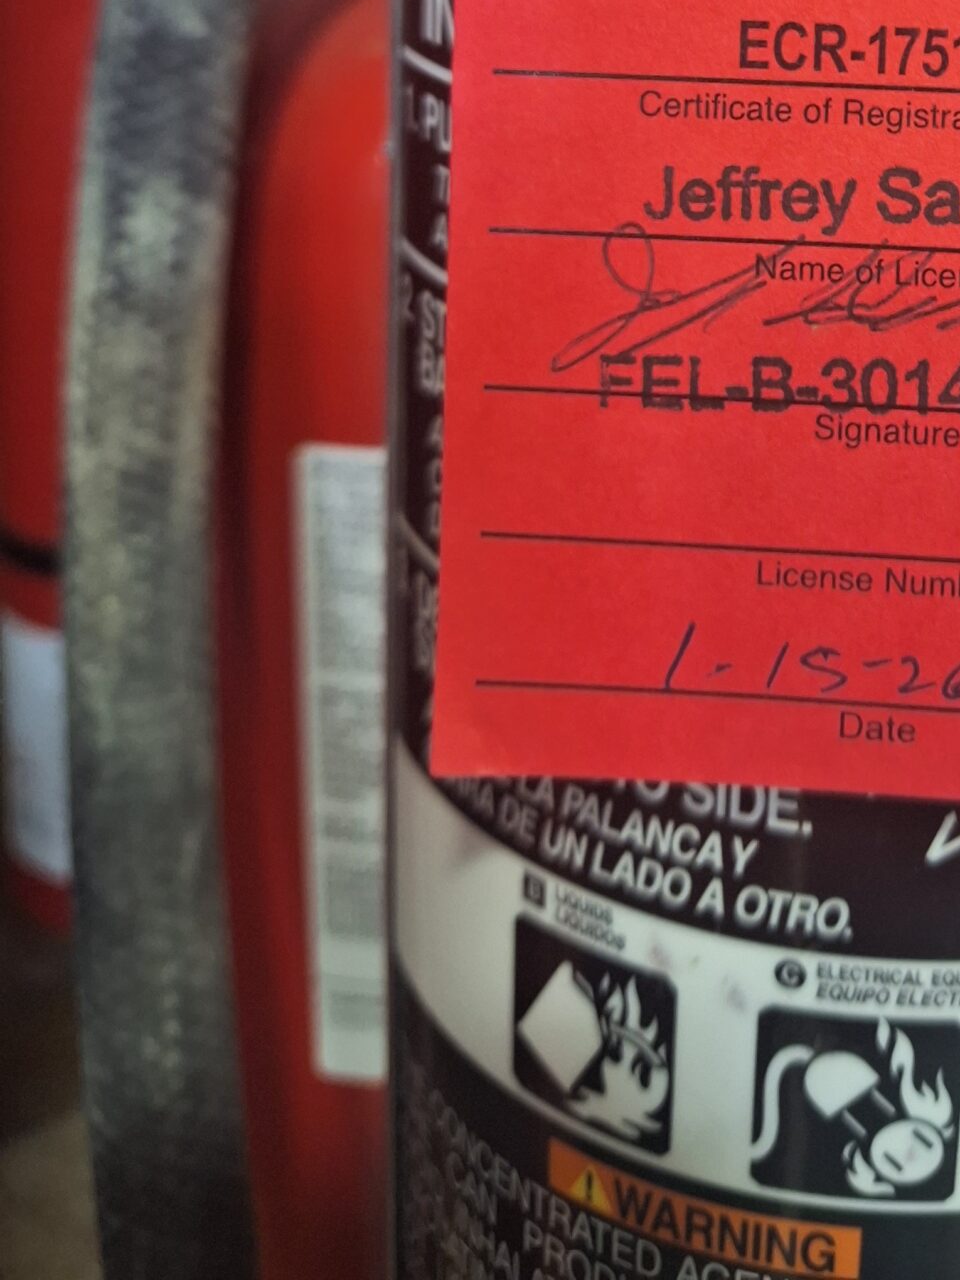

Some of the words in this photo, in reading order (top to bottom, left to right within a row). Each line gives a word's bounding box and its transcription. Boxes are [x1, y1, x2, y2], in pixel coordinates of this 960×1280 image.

[639, 90, 792, 125] Certificate
[802, 93, 833, 126] of
[643, 164, 857, 237] Jeffrey
[754, 253, 845, 287] Name
[854, 256, 887, 288] of
[815, 413, 960, 456] Signature
[756, 559, 874, 596] License
[838, 710, 916, 747] Date
[563, 782, 725, 872] PALANCA
[541, 817, 589, 872] UN
[590, 842, 693, 905] LADO
[695, 876, 726, 919] A
[735, 884, 855, 942] OTRO.
[816, 959, 923, 986] ELECTRICAL
[613, 1176, 836, 1274] WARNING
